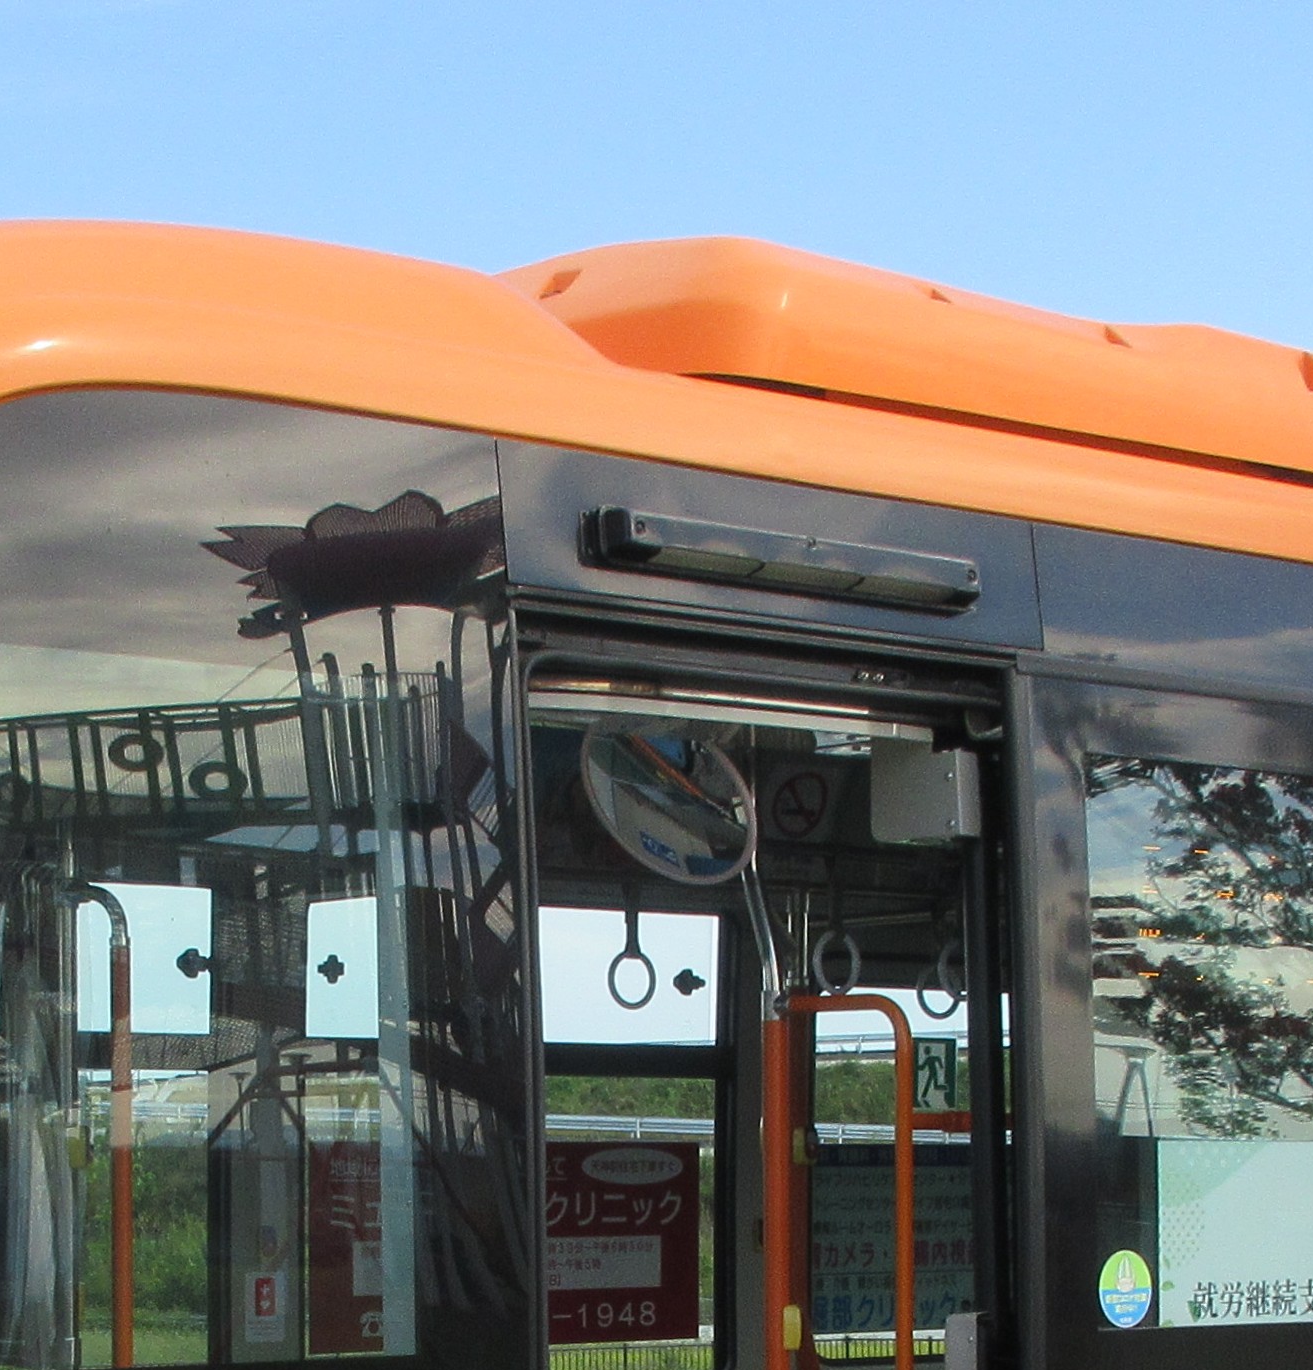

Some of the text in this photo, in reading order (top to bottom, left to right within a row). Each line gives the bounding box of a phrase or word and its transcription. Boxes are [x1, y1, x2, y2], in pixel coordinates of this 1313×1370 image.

[546, 1189, 684, 1227] クリニック
